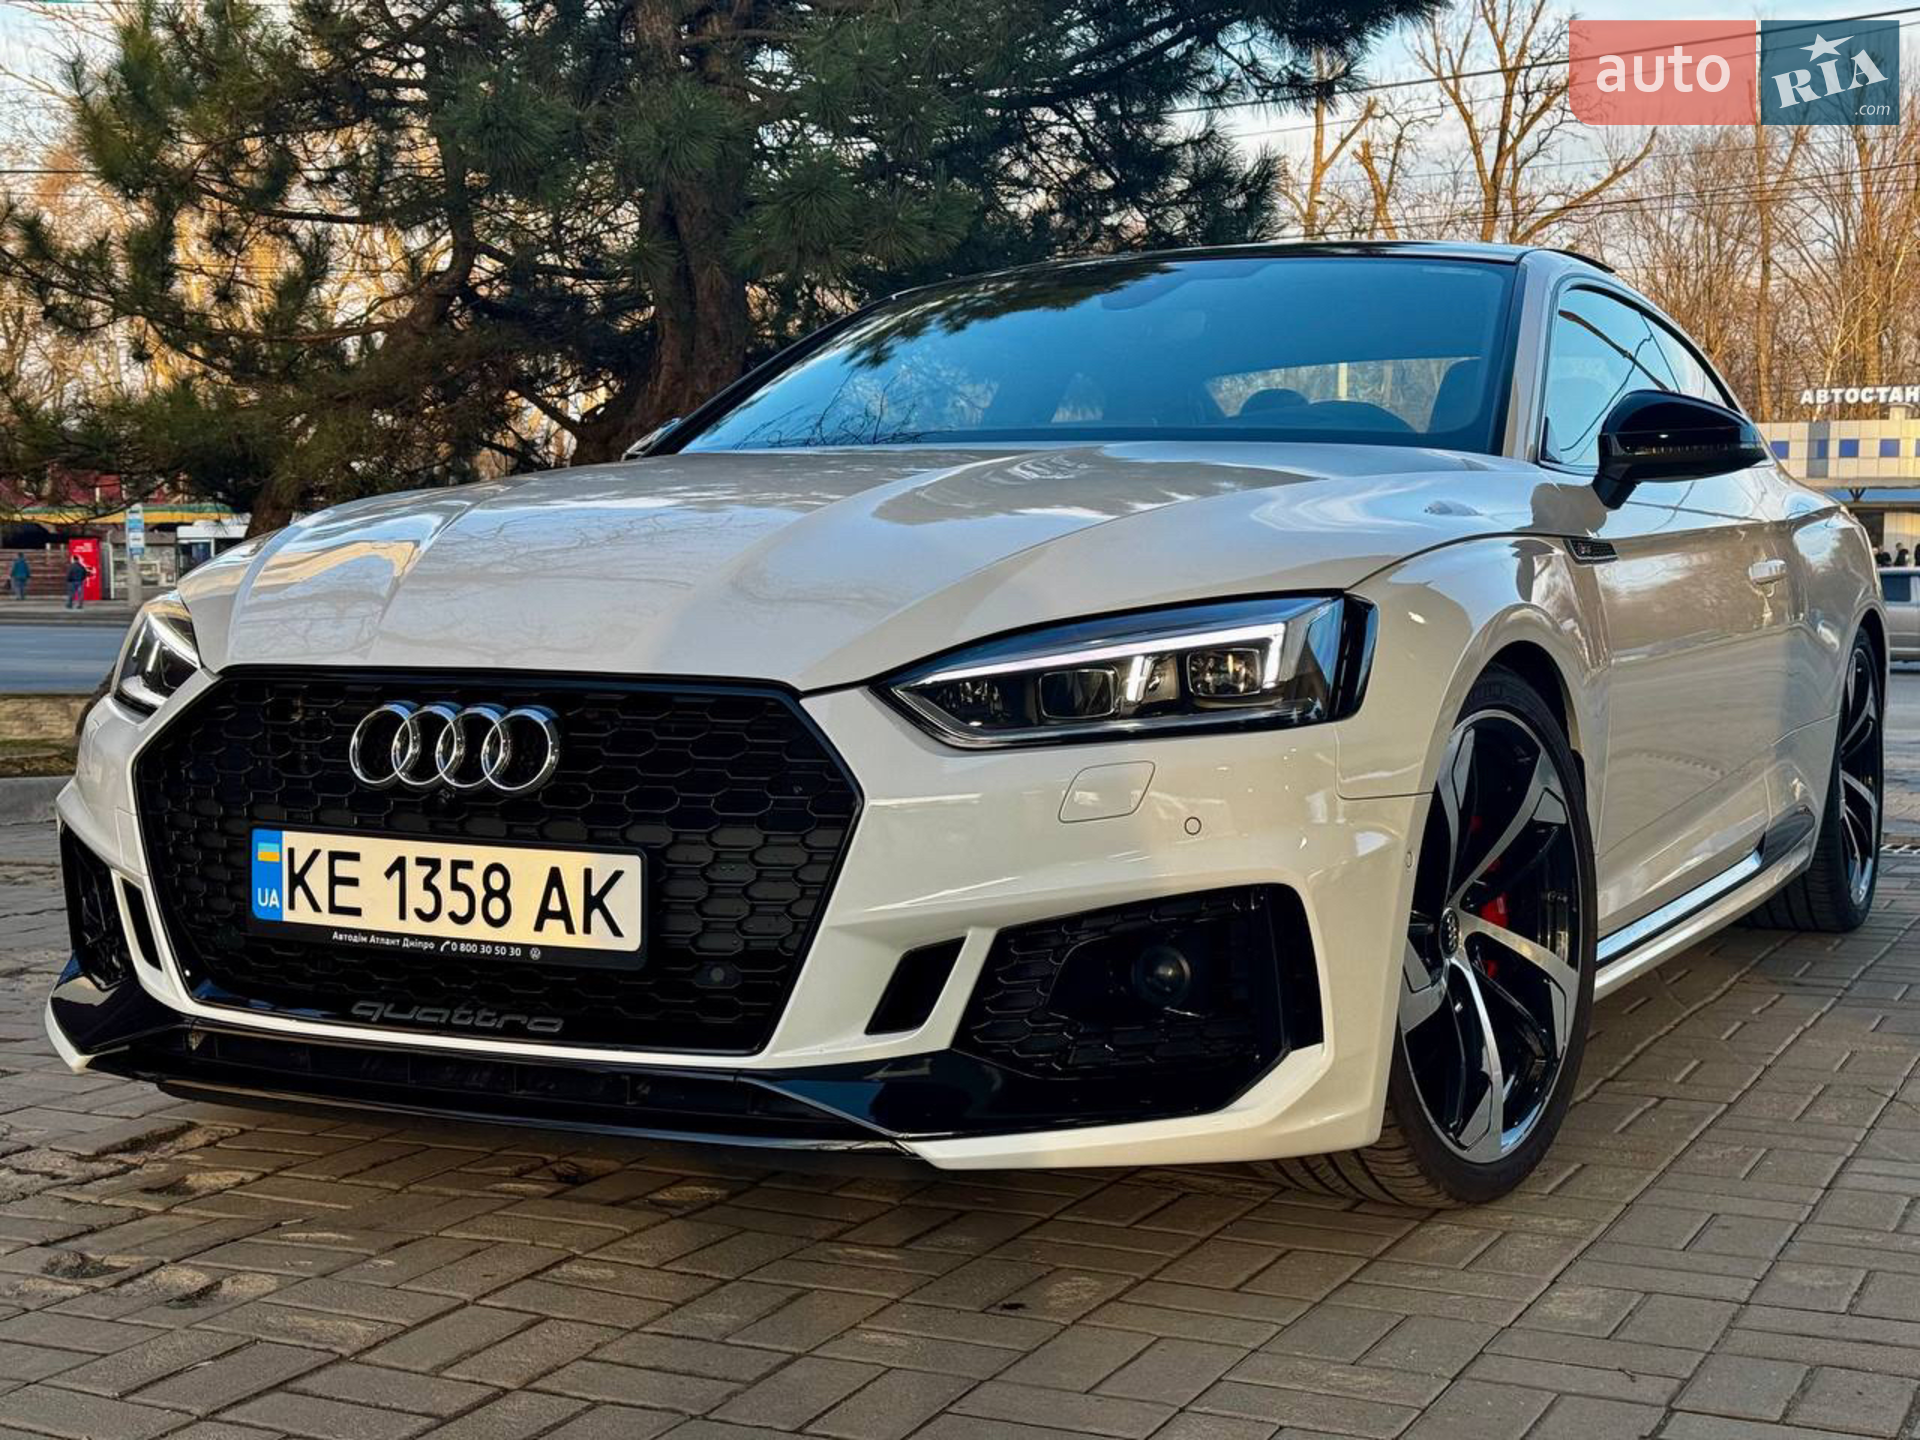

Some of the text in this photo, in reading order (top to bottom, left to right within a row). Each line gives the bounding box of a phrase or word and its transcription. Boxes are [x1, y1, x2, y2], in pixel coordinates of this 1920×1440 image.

[1800, 385, 1920, 405] АВТОСТАН
[257, 887, 280, 908] UA
[287, 846, 625, 938] KE 1358 AK
[451, 942, 458, 952] 0
[459, 943, 478, 954] 800
[480, 945, 492, 955] 30
[494, 946, 507, 956] 50
[509, 947, 521, 957] 30
[351, 1001, 564, 1033] quattro
